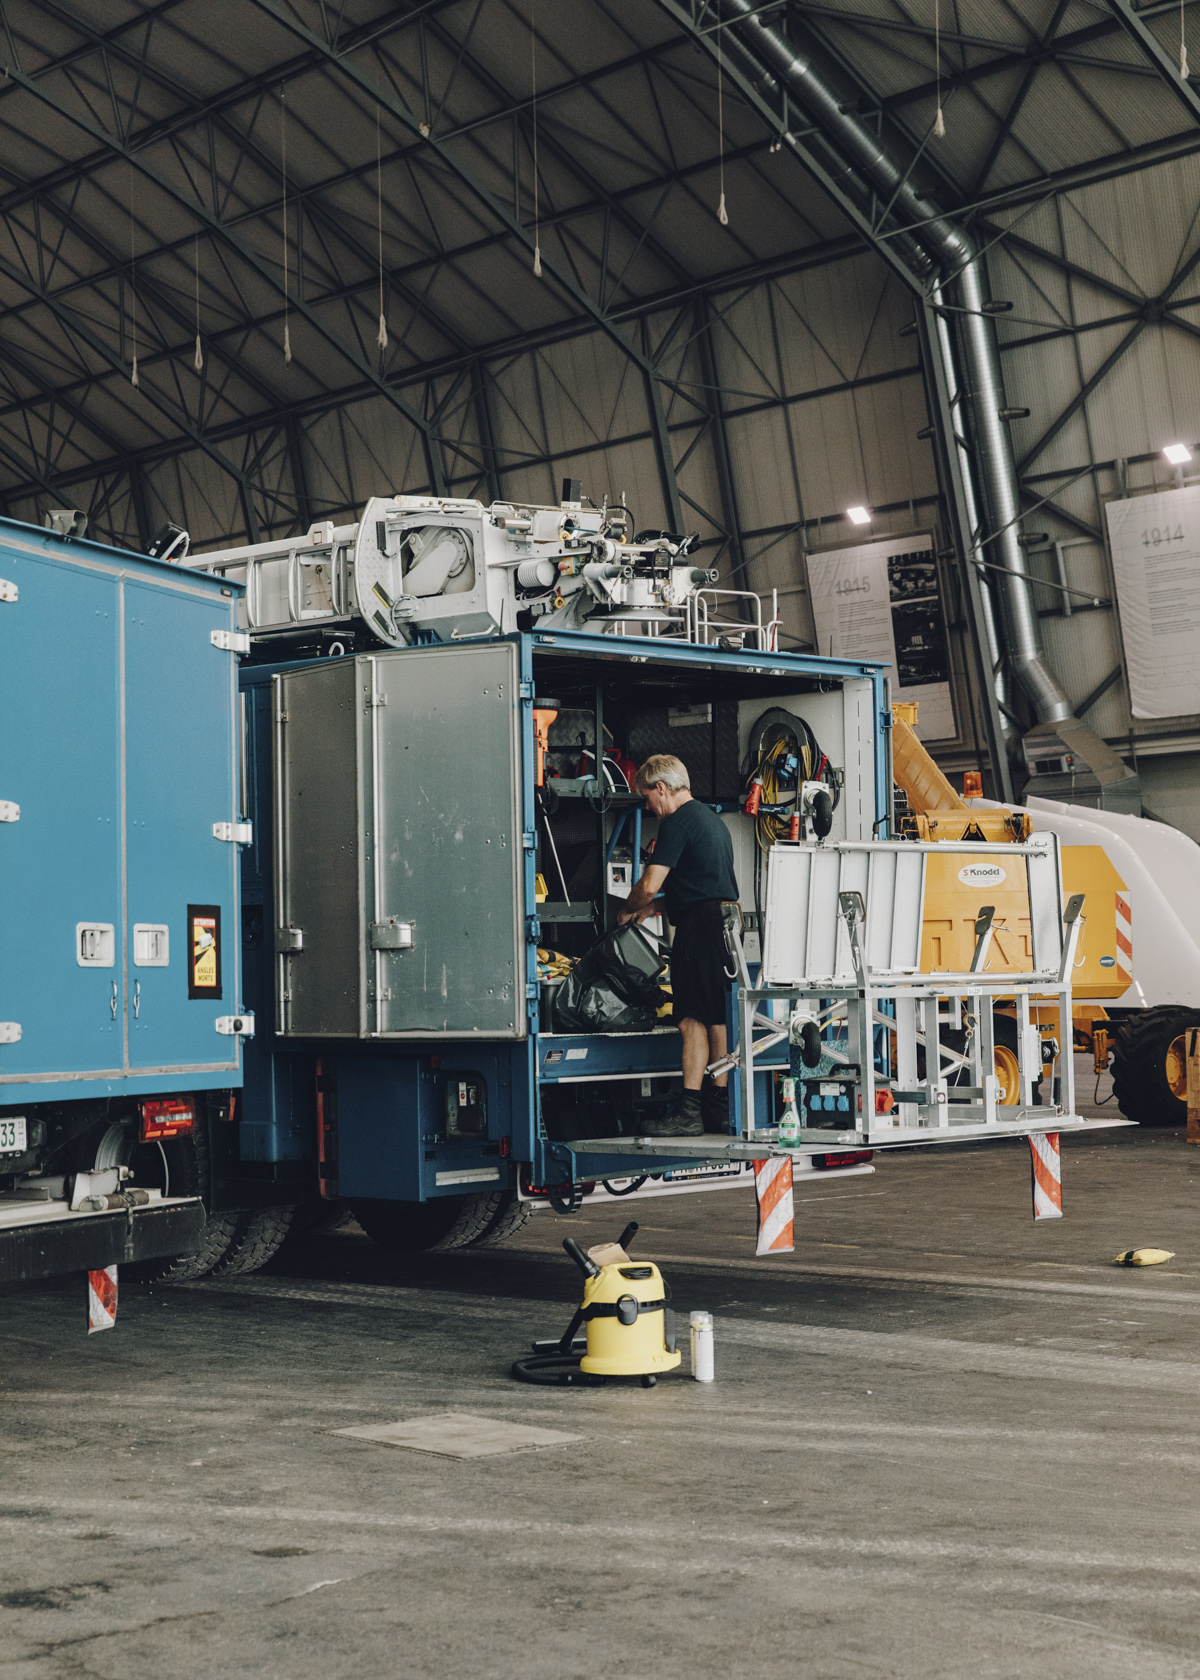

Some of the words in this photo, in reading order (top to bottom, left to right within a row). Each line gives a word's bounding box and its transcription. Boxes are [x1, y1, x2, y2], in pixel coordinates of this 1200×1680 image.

[1141, 523, 1184, 548] 1914
[836, 576, 870, 596] 1915
[197, 966, 214, 974] ANGLES
[198, 974, 213, 982] MORTS
